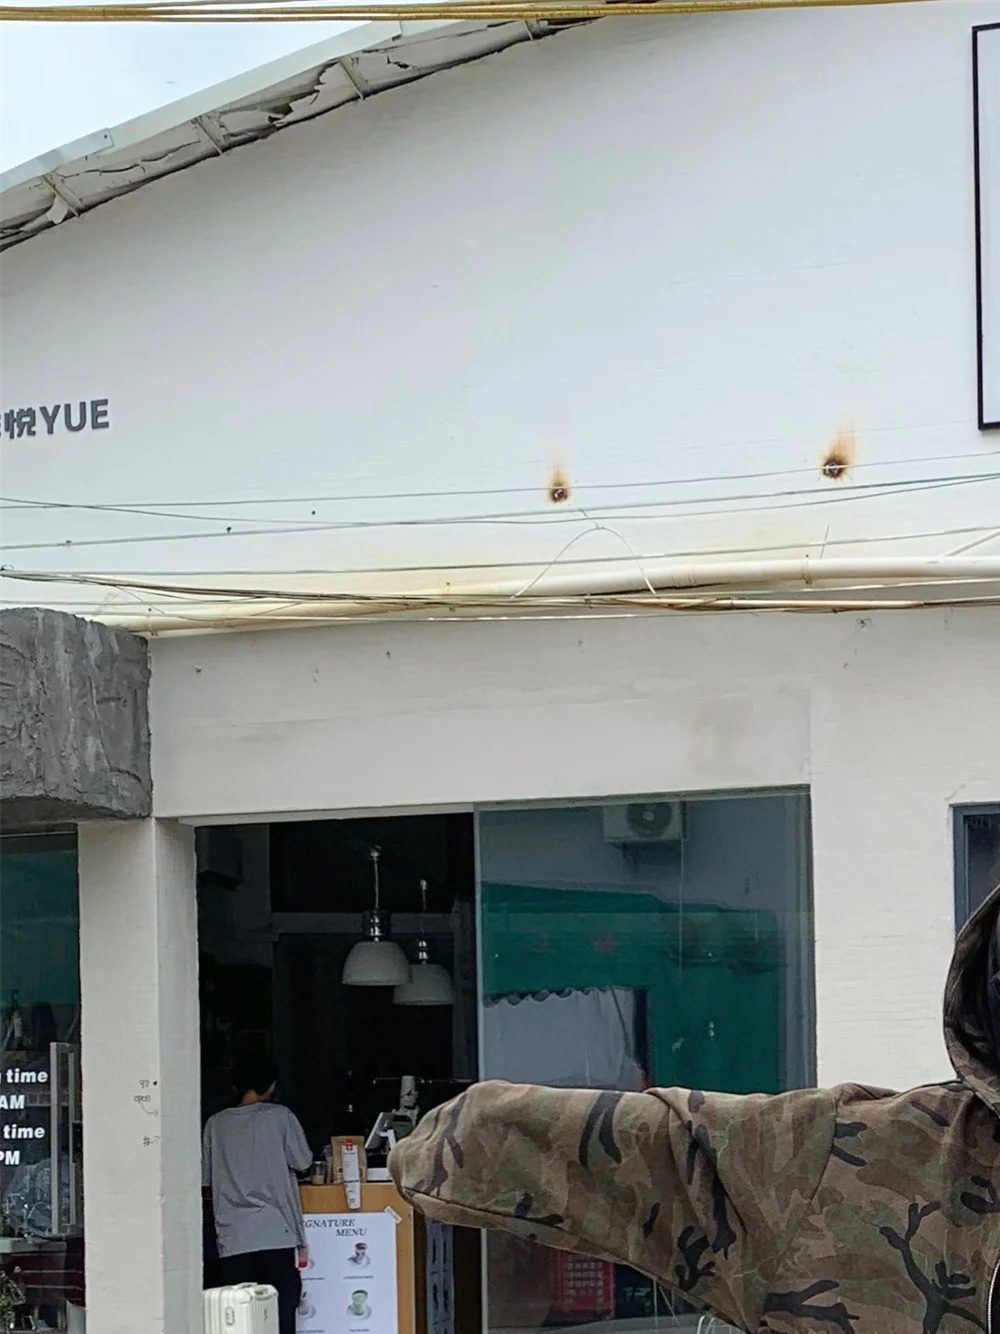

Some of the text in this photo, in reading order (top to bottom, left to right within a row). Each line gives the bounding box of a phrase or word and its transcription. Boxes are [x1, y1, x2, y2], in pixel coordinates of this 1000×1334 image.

[6, 1068, 48, 1084] time
[3, 1124, 45, 1139] time
[303, 1218, 356, 1229] GNATURE
[335, 1227, 368, 1238] MENU
